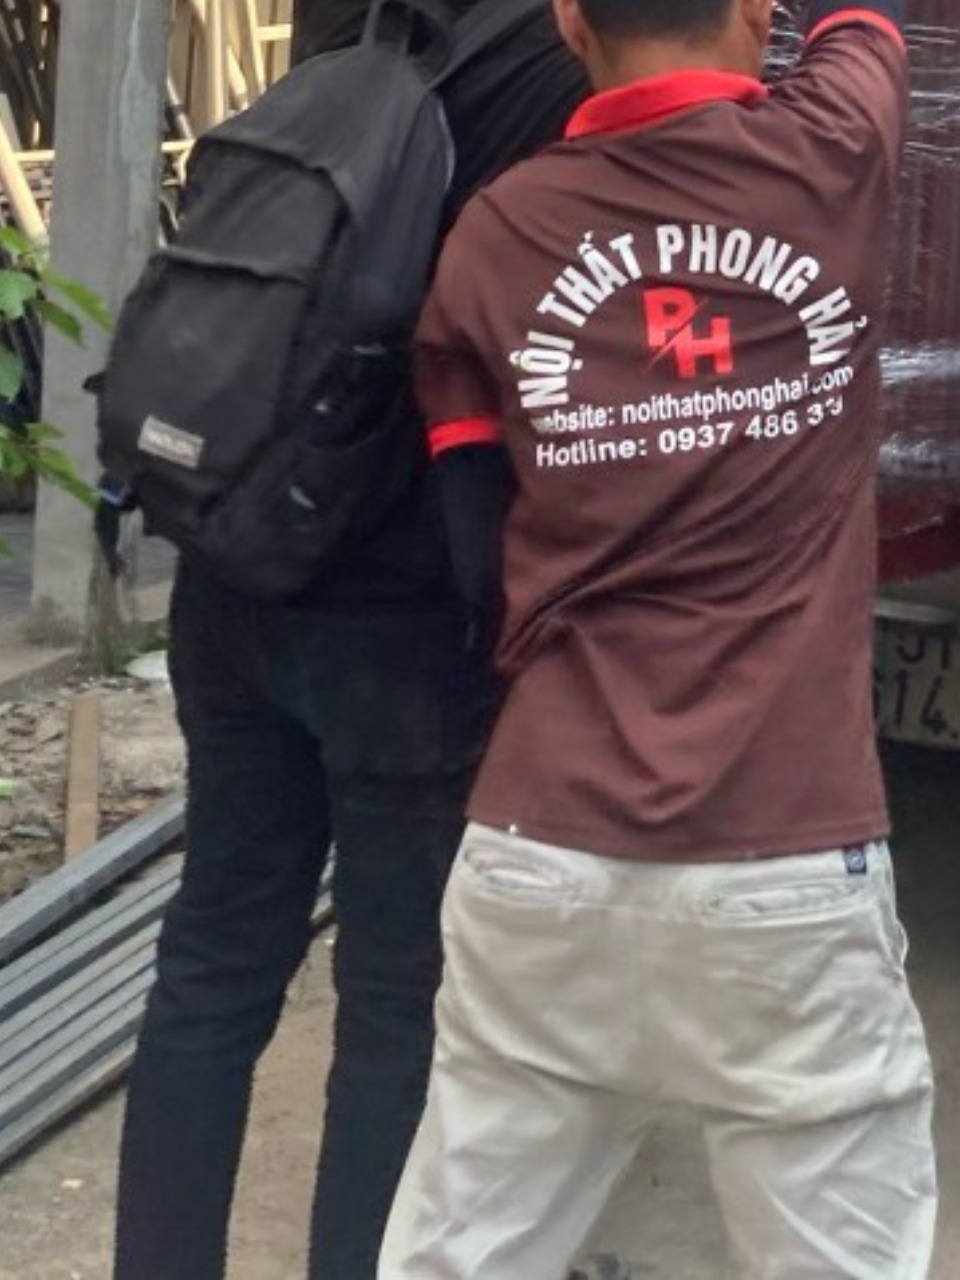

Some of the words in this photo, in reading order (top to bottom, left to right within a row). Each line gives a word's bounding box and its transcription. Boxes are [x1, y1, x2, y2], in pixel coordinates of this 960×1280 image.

[536, 230, 643, 328] THẤT
[656, 223, 821, 306] PHONG
[509, 330, 583, 408] NỘI
[535, 437, 648, 467] Hotline:
[658, 421, 736, 455] 0937
[744, 408, 799, 440] 486
